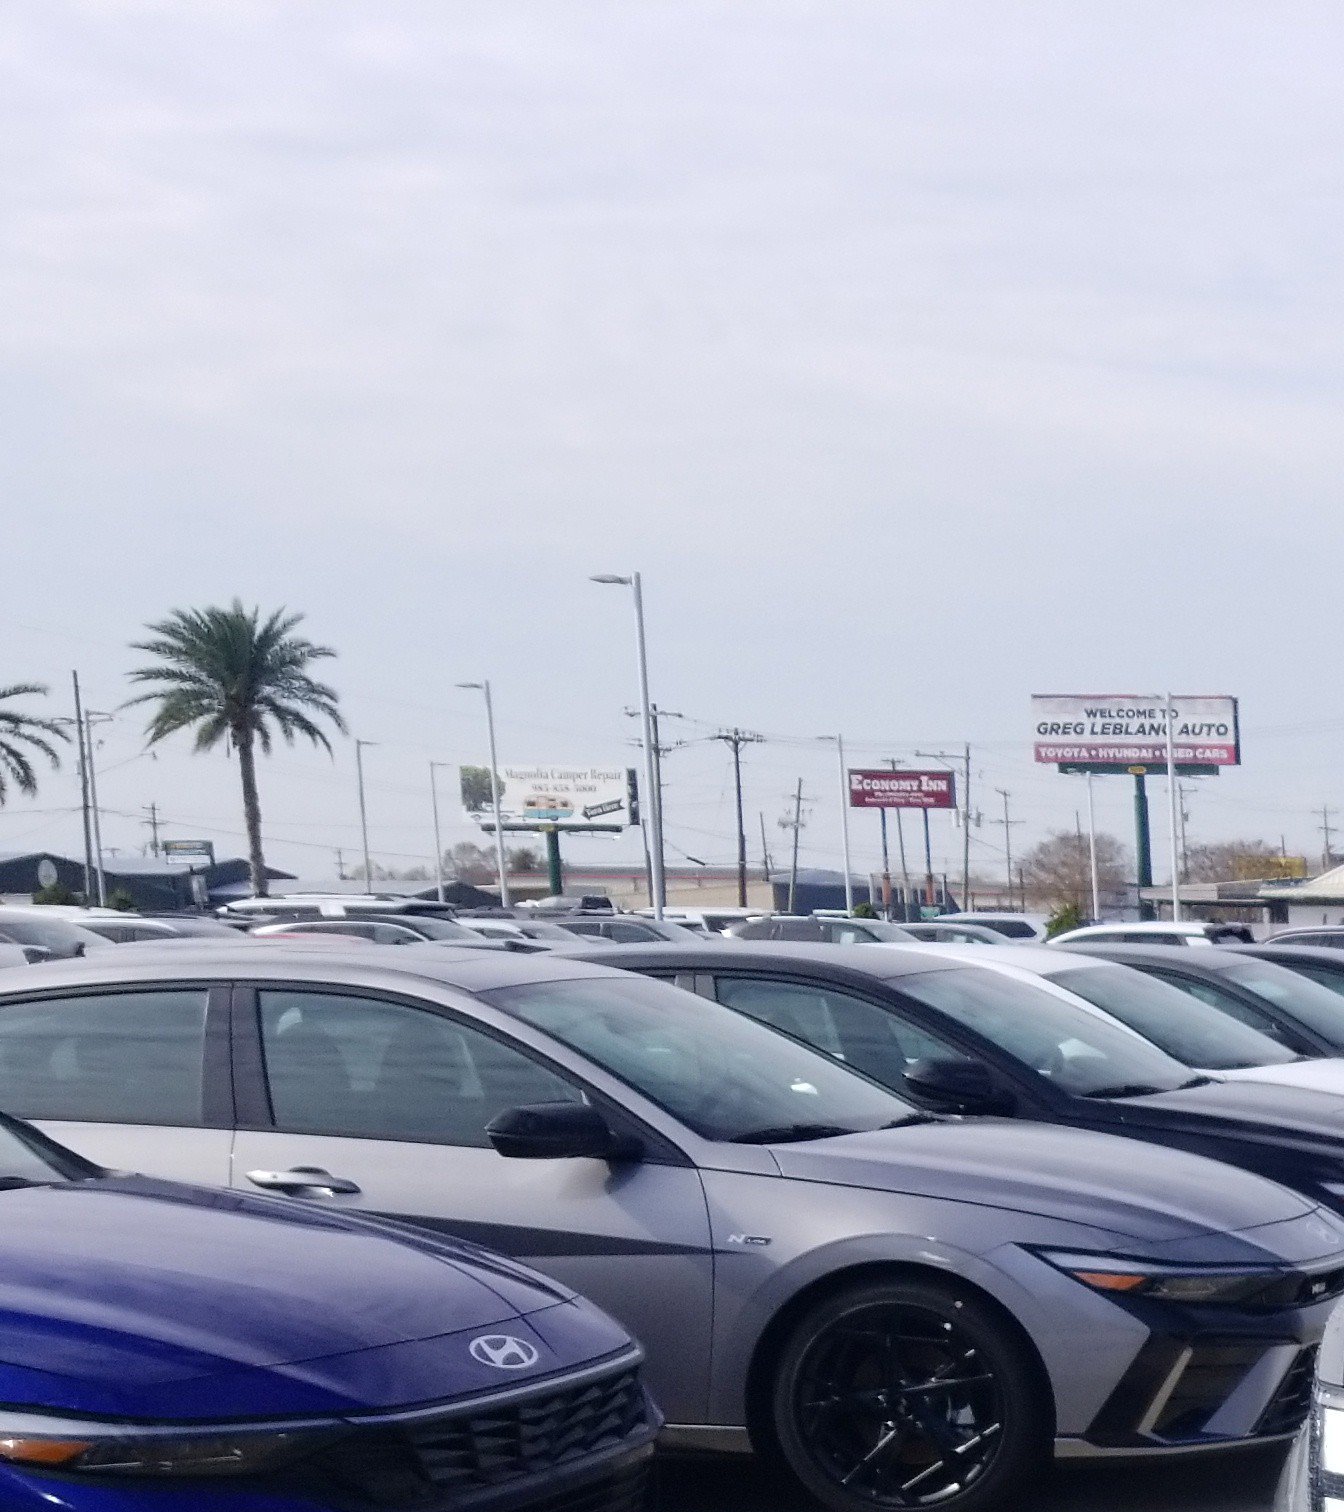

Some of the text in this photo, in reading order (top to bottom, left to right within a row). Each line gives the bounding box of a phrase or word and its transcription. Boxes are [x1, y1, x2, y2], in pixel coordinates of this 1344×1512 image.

[1084, 708, 1179, 719] WELCOME TO
[1037, 722, 1085, 735] GREG
[1178, 723, 1228, 736] AUTO
[1038, 747, 1089, 758] TOYOTA
[1099, 748, 1153, 758] HYUNDAI
[1195, 748, 1228, 759] CARS
[506, 768, 622, 783] Magnolia Camper Repair
[850, 775, 947, 792] ECONOMY INN
